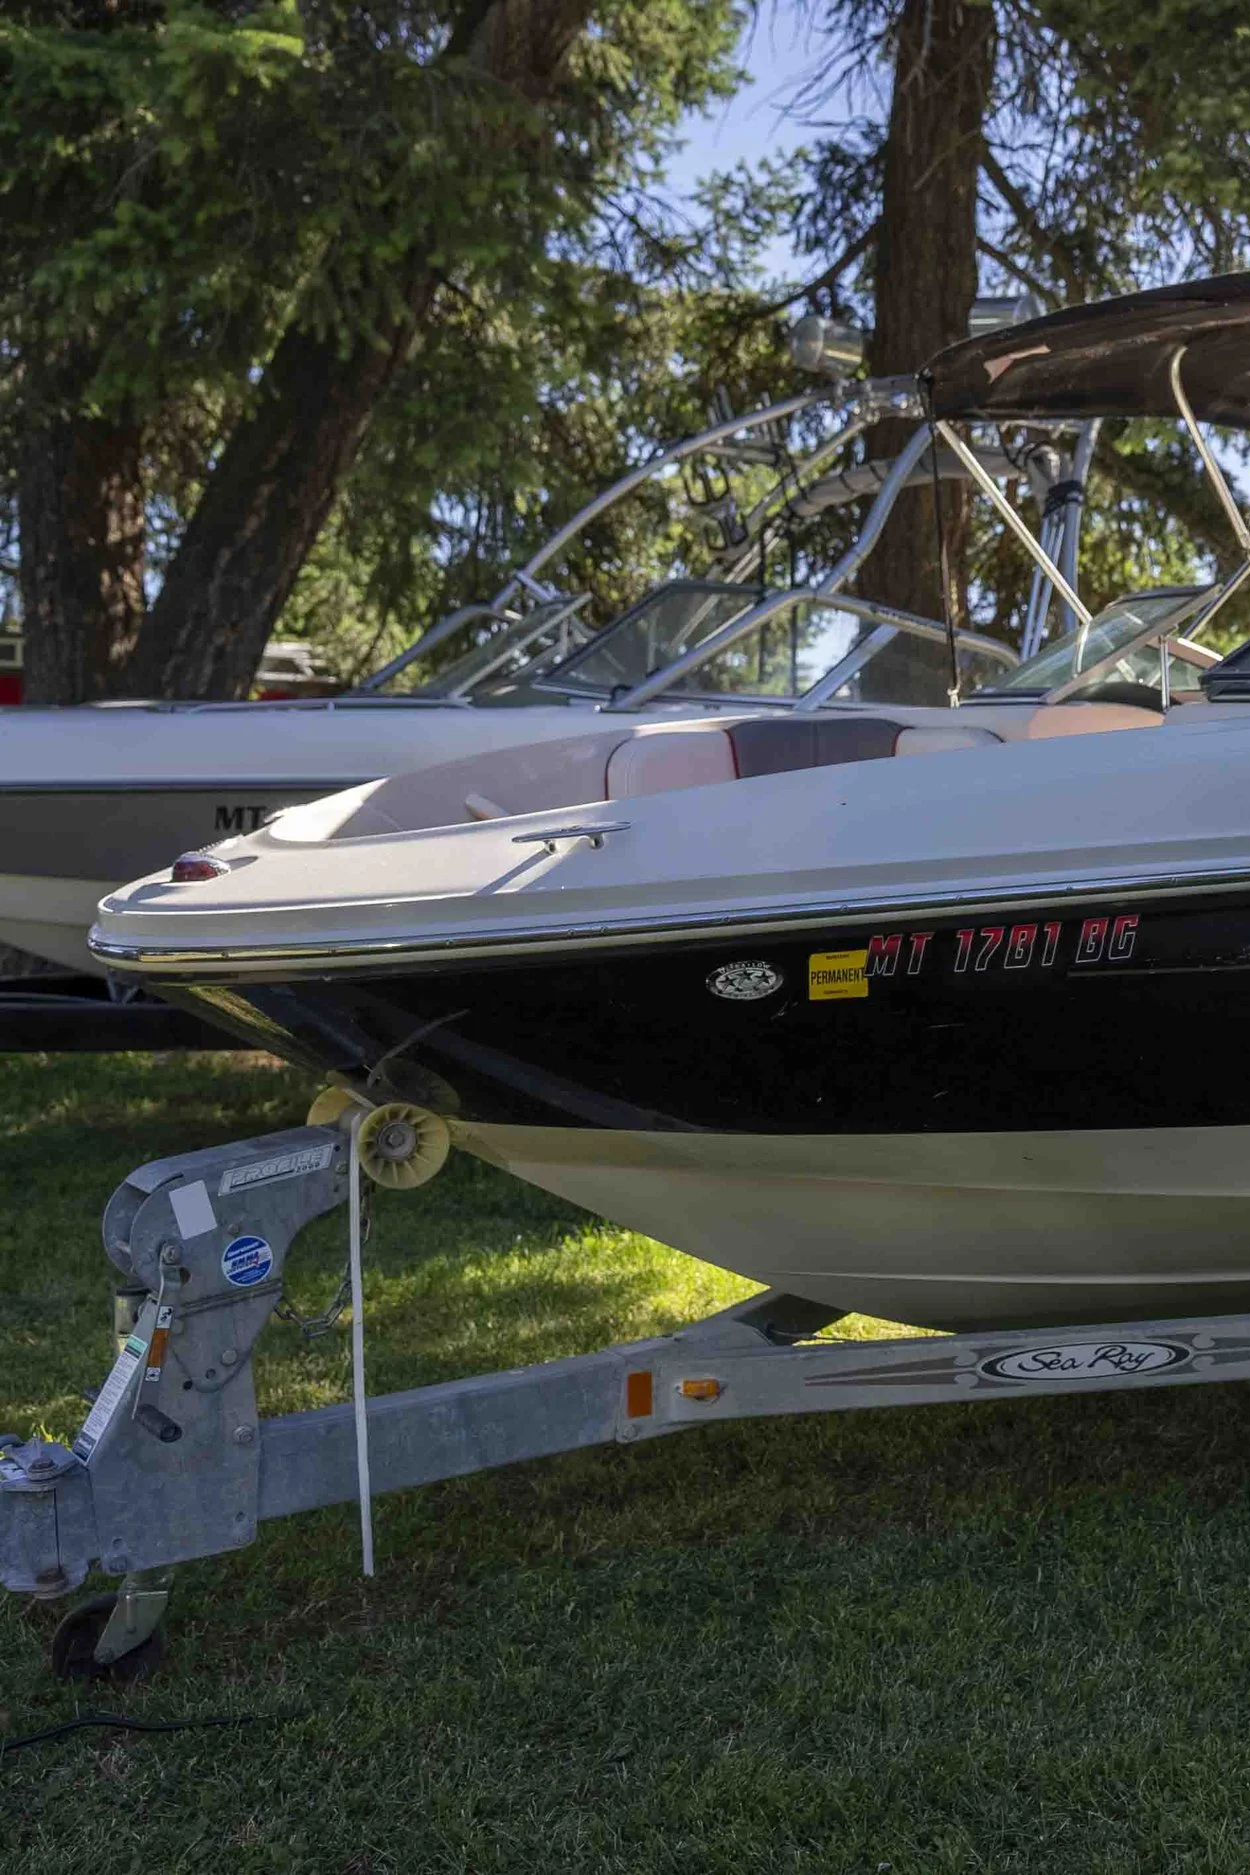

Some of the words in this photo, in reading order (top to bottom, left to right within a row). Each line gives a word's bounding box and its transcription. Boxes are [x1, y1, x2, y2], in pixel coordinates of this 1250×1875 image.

[216, 805, 267, 831] MT
[864, 931, 935, 977] MT
[1075, 914, 1141, 964] BG
[810, 967, 867, 986] PERMANENT
[1018, 1350, 1084, 1373] Sea
[1087, 1344, 1155, 1371] Ray
